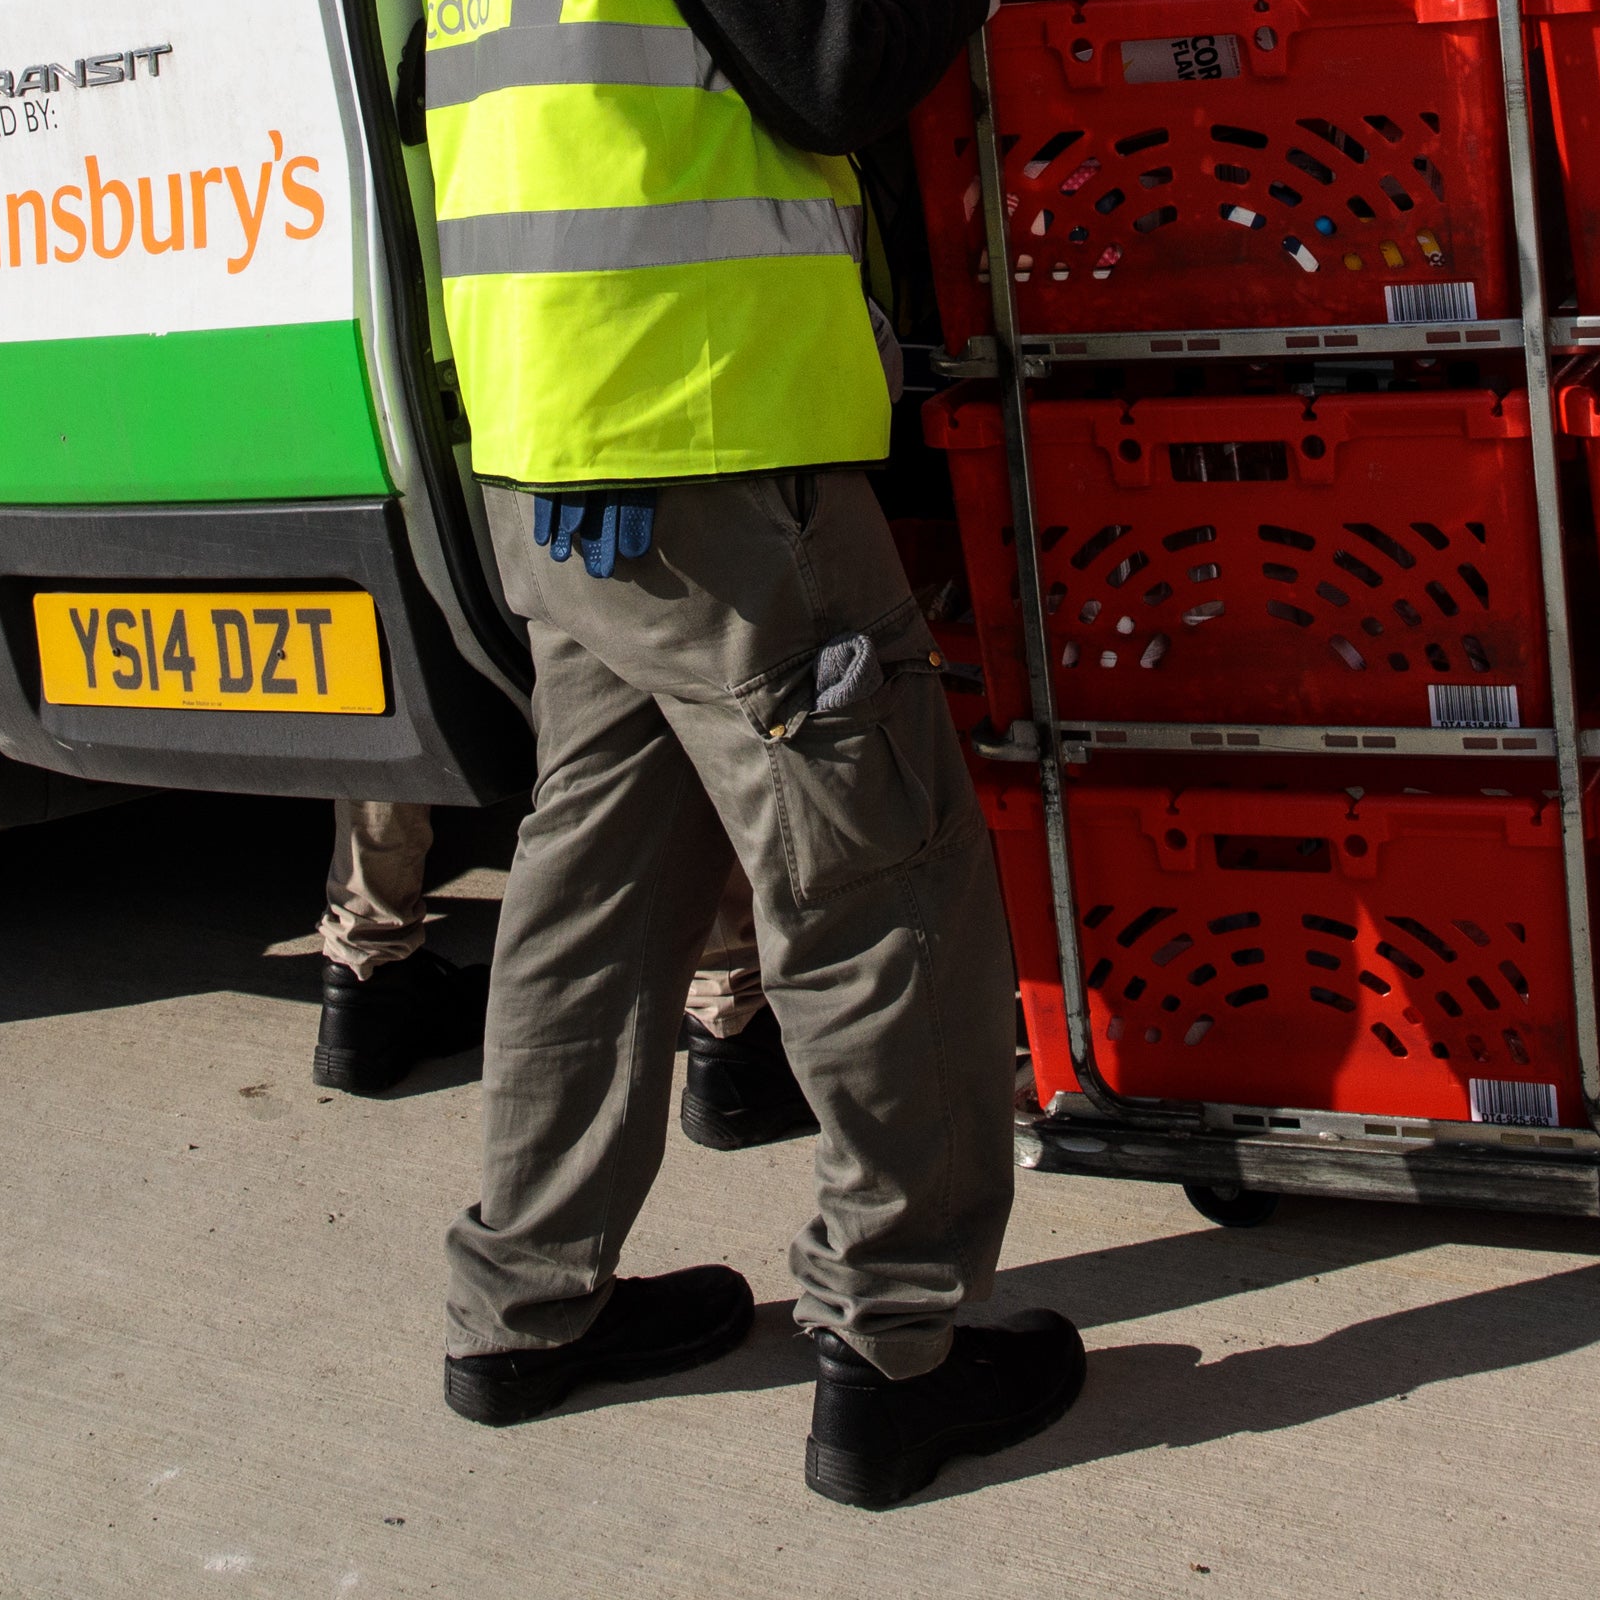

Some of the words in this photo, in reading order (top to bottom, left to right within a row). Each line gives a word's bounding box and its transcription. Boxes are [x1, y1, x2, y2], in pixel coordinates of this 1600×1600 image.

[1191, 35, 1222, 79] COR
[26, 98, 58, 132] BY:
[69, 607, 196, 692] YS14
[211, 608, 332, 695] DZT
